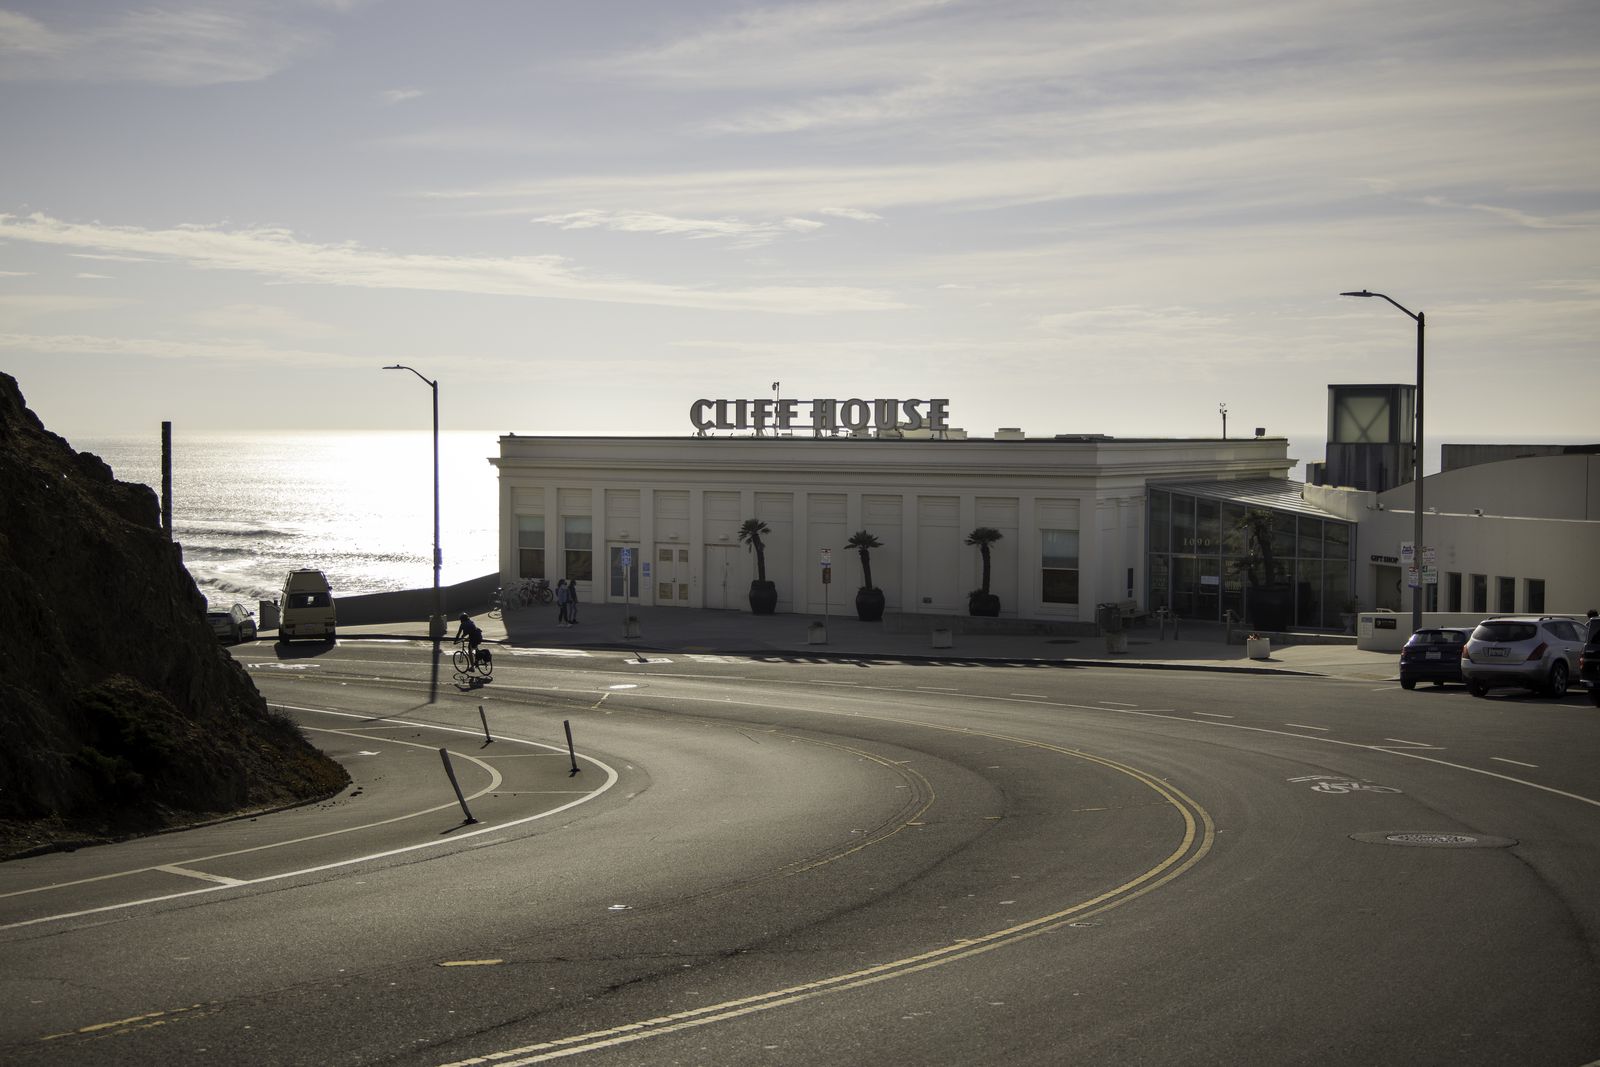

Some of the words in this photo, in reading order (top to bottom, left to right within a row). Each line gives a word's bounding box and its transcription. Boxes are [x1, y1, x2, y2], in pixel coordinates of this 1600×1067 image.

[690, 398, 798, 430] CLIFF
[810, 398, 949, 430] HOUSE
[1184, 538, 1210, 546] 1090
